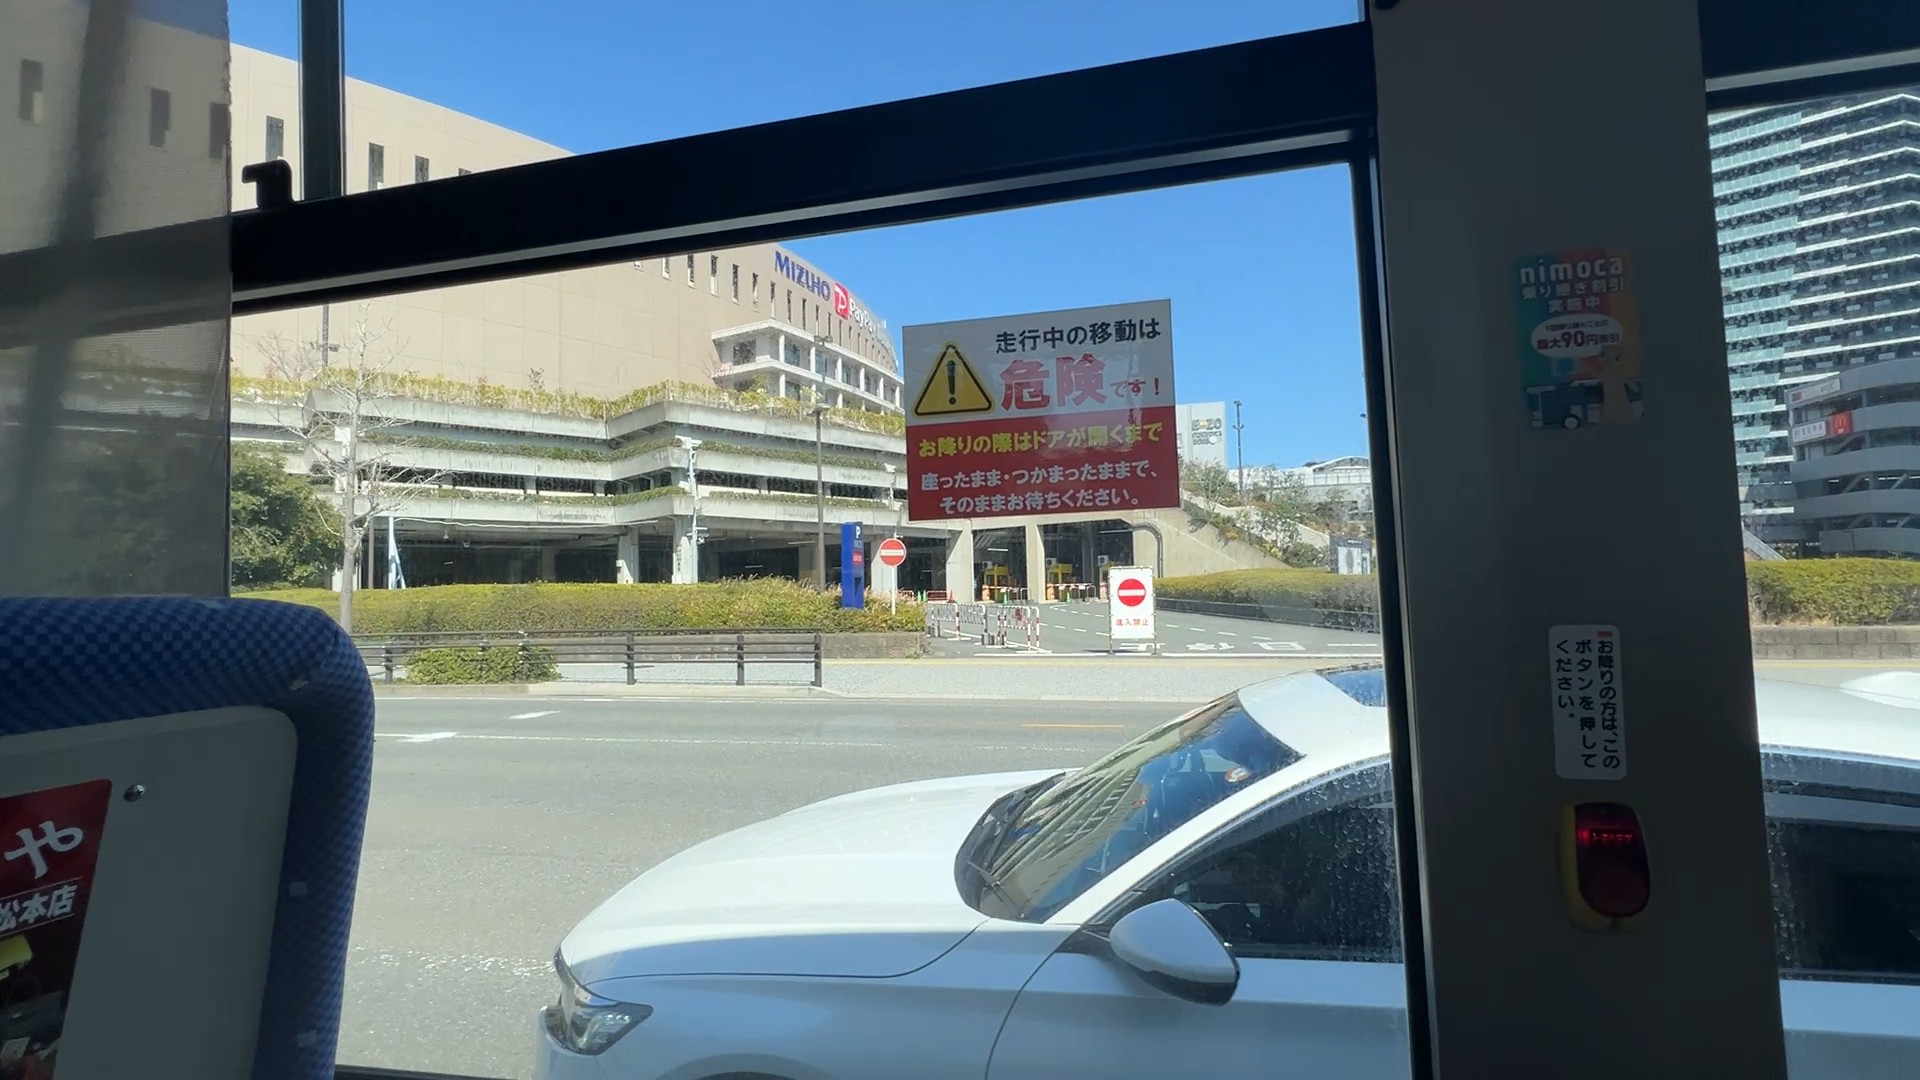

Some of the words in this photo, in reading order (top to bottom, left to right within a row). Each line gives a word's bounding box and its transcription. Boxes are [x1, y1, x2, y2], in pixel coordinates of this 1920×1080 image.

[775, 250, 831, 302] MIZUHO
[1520, 256, 1624, 285] nimoca
[996, 318, 1161, 354] 走行中の移動は
[919, 422, 1163, 457] お降りの際はドアが開くまで
[940, 488, 1139, 514] そのままお待ちください。
[1555, 639, 1575, 718] ください。
[1575, 639, 1597, 768] ボタンを押して
[1597, 640, 1620, 769] お降りの方は、この
[4, 820, 84, 880] や
